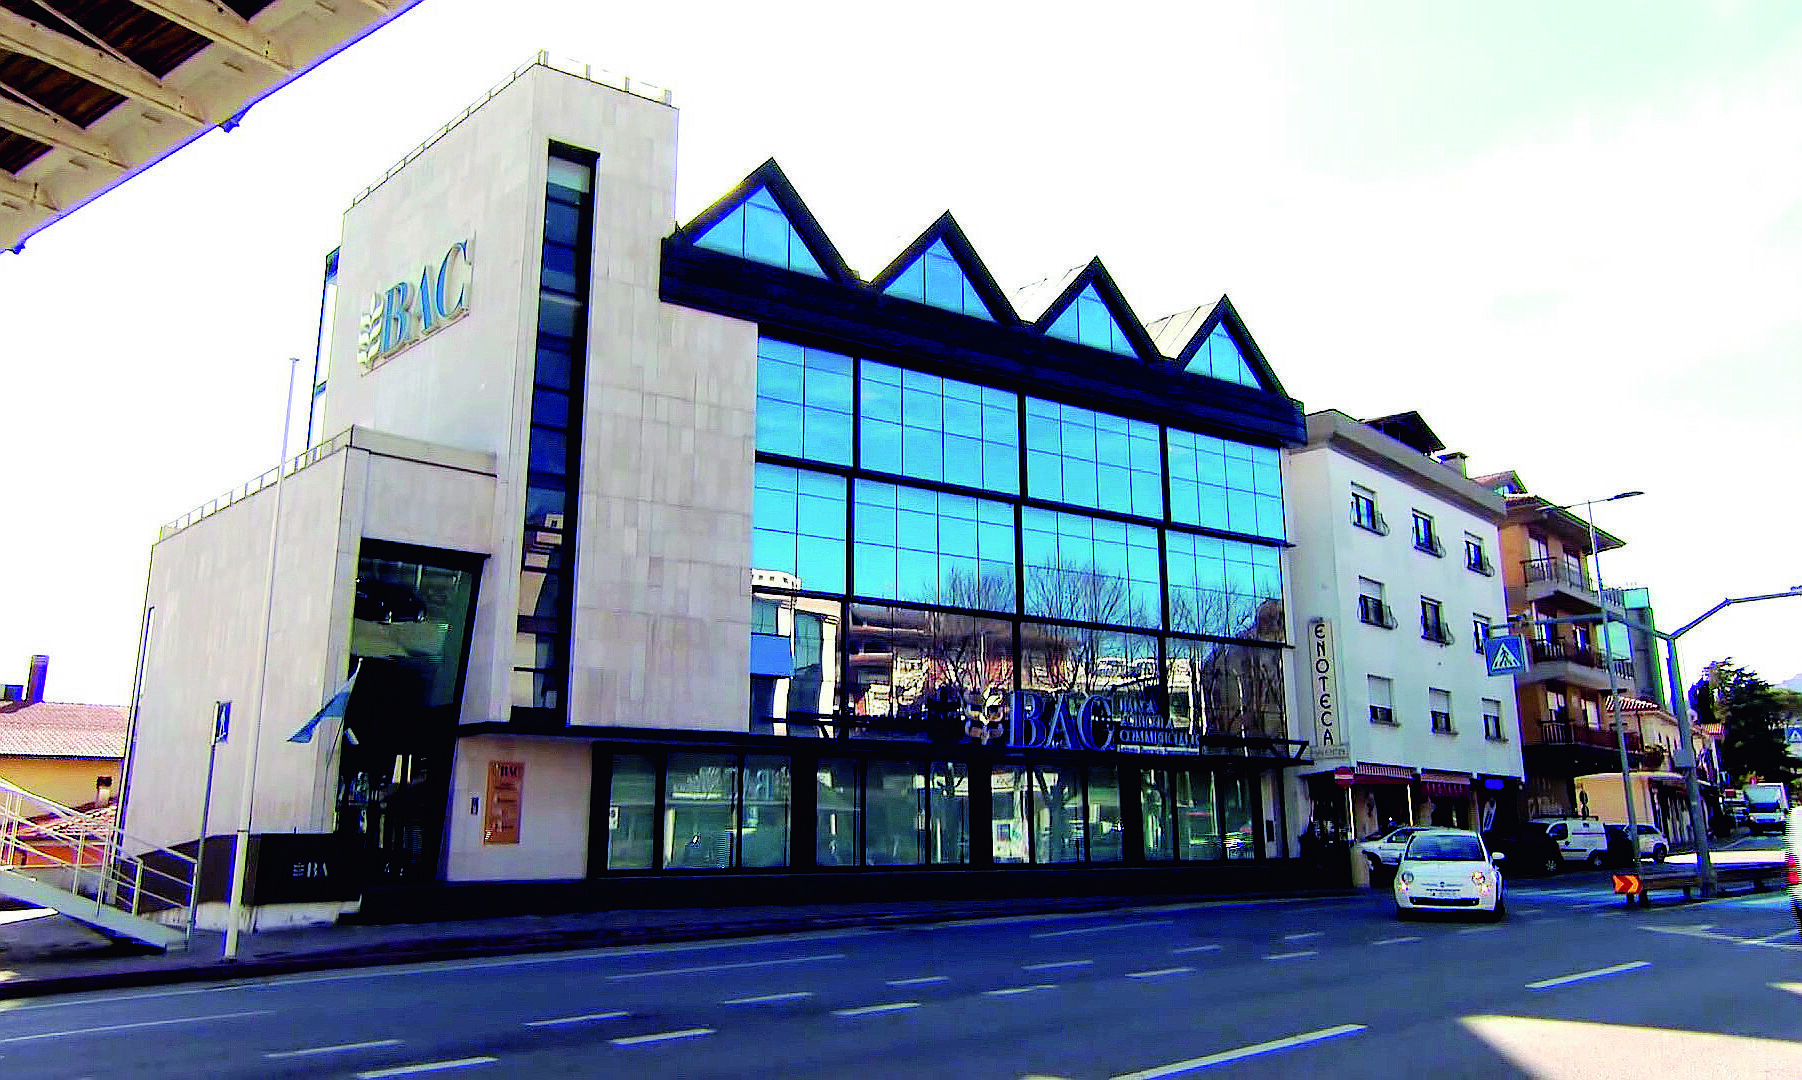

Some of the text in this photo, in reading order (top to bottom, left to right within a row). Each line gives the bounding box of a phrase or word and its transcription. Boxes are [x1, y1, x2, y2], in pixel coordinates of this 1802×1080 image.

[379, 239, 471, 354] BAC
[1005, 690, 1117, 751] BAC
[1314, 623, 1334, 747] ENOTECA
